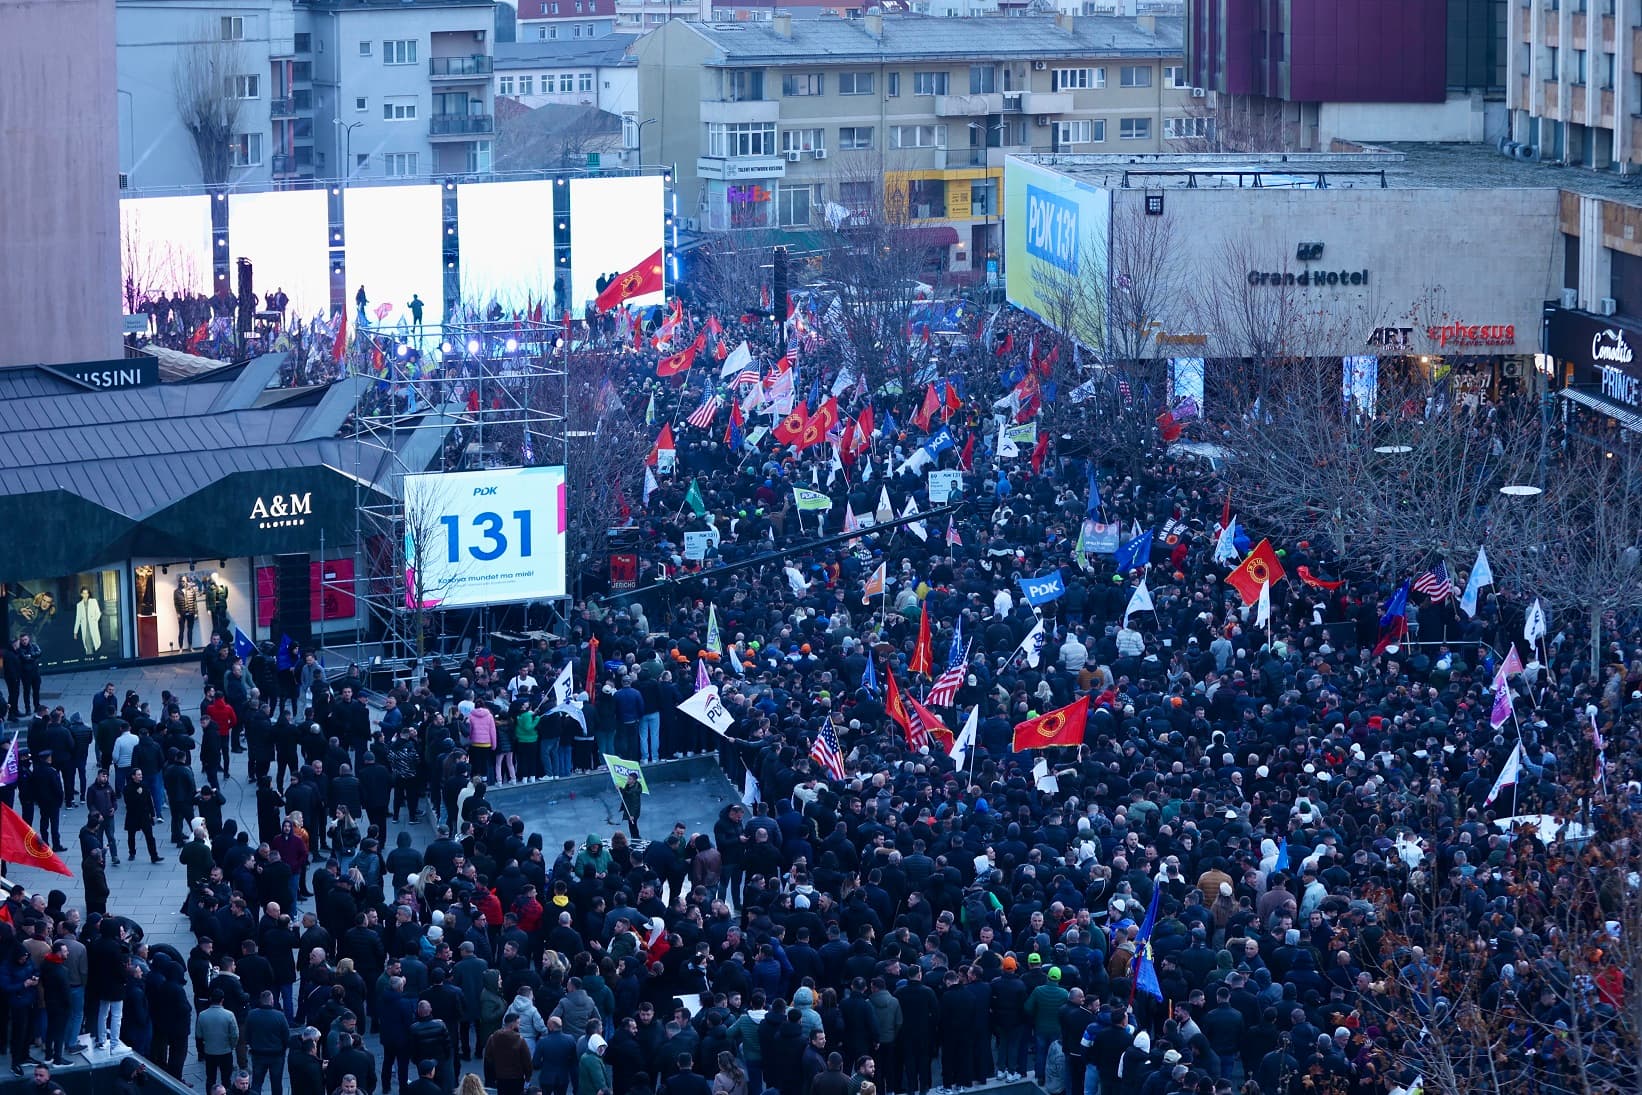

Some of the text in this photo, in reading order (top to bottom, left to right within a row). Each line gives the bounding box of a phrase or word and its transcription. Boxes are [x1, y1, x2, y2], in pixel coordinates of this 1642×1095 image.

[727, 185, 772, 203] FedEx
[1028, 195, 1077, 263] PDK 131
[1248, 269, 1369, 287] Grand Hotel
[1366, 327, 1413, 345] ART
[1592, 329, 1633, 363] Comodita
[1601, 367, 1639, 407] PRINCE
[473, 486, 498, 496] PDK
[249, 492, 312, 519] A&M
[440, 510, 532, 563] 131
[468, 573, 499, 582] mundet
[1029, 579, 1060, 598] PDK
